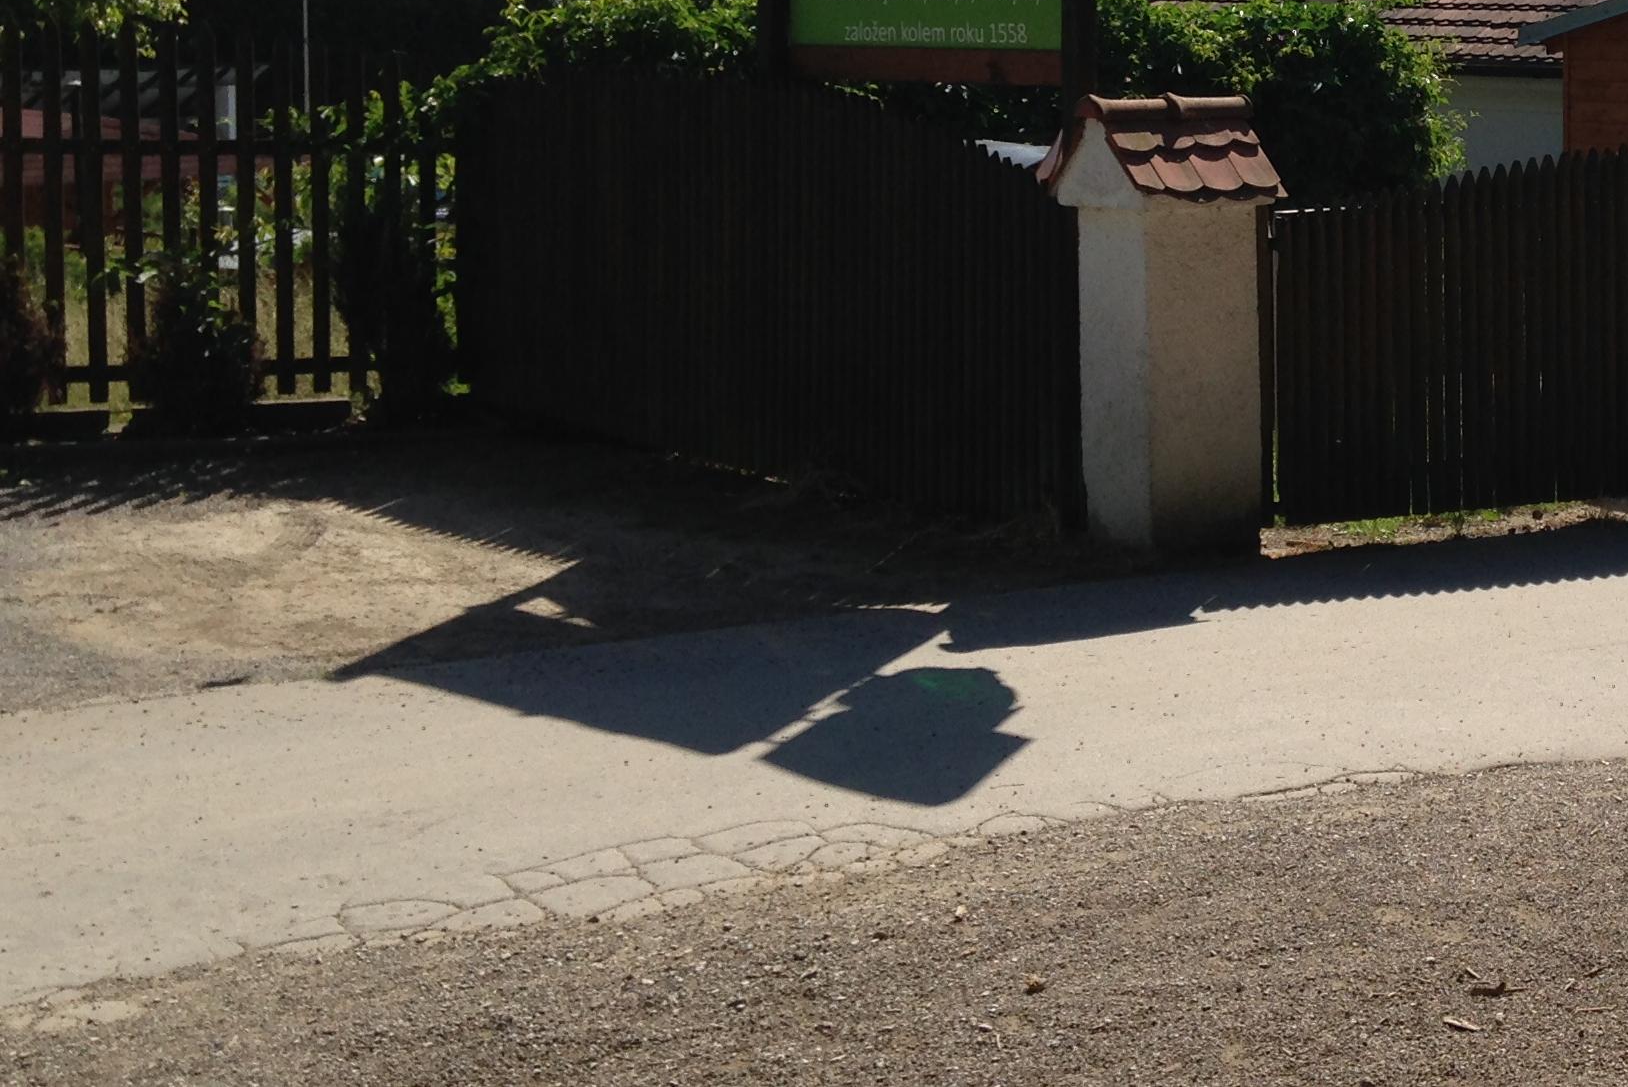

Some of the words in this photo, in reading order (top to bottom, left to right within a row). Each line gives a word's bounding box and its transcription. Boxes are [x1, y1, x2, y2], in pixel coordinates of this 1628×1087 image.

[844, 20, 897, 43] založen
[900, 20, 946, 42] kolem
[950, 22, 985, 44] roku
[989, 22, 1028, 44] 1558
